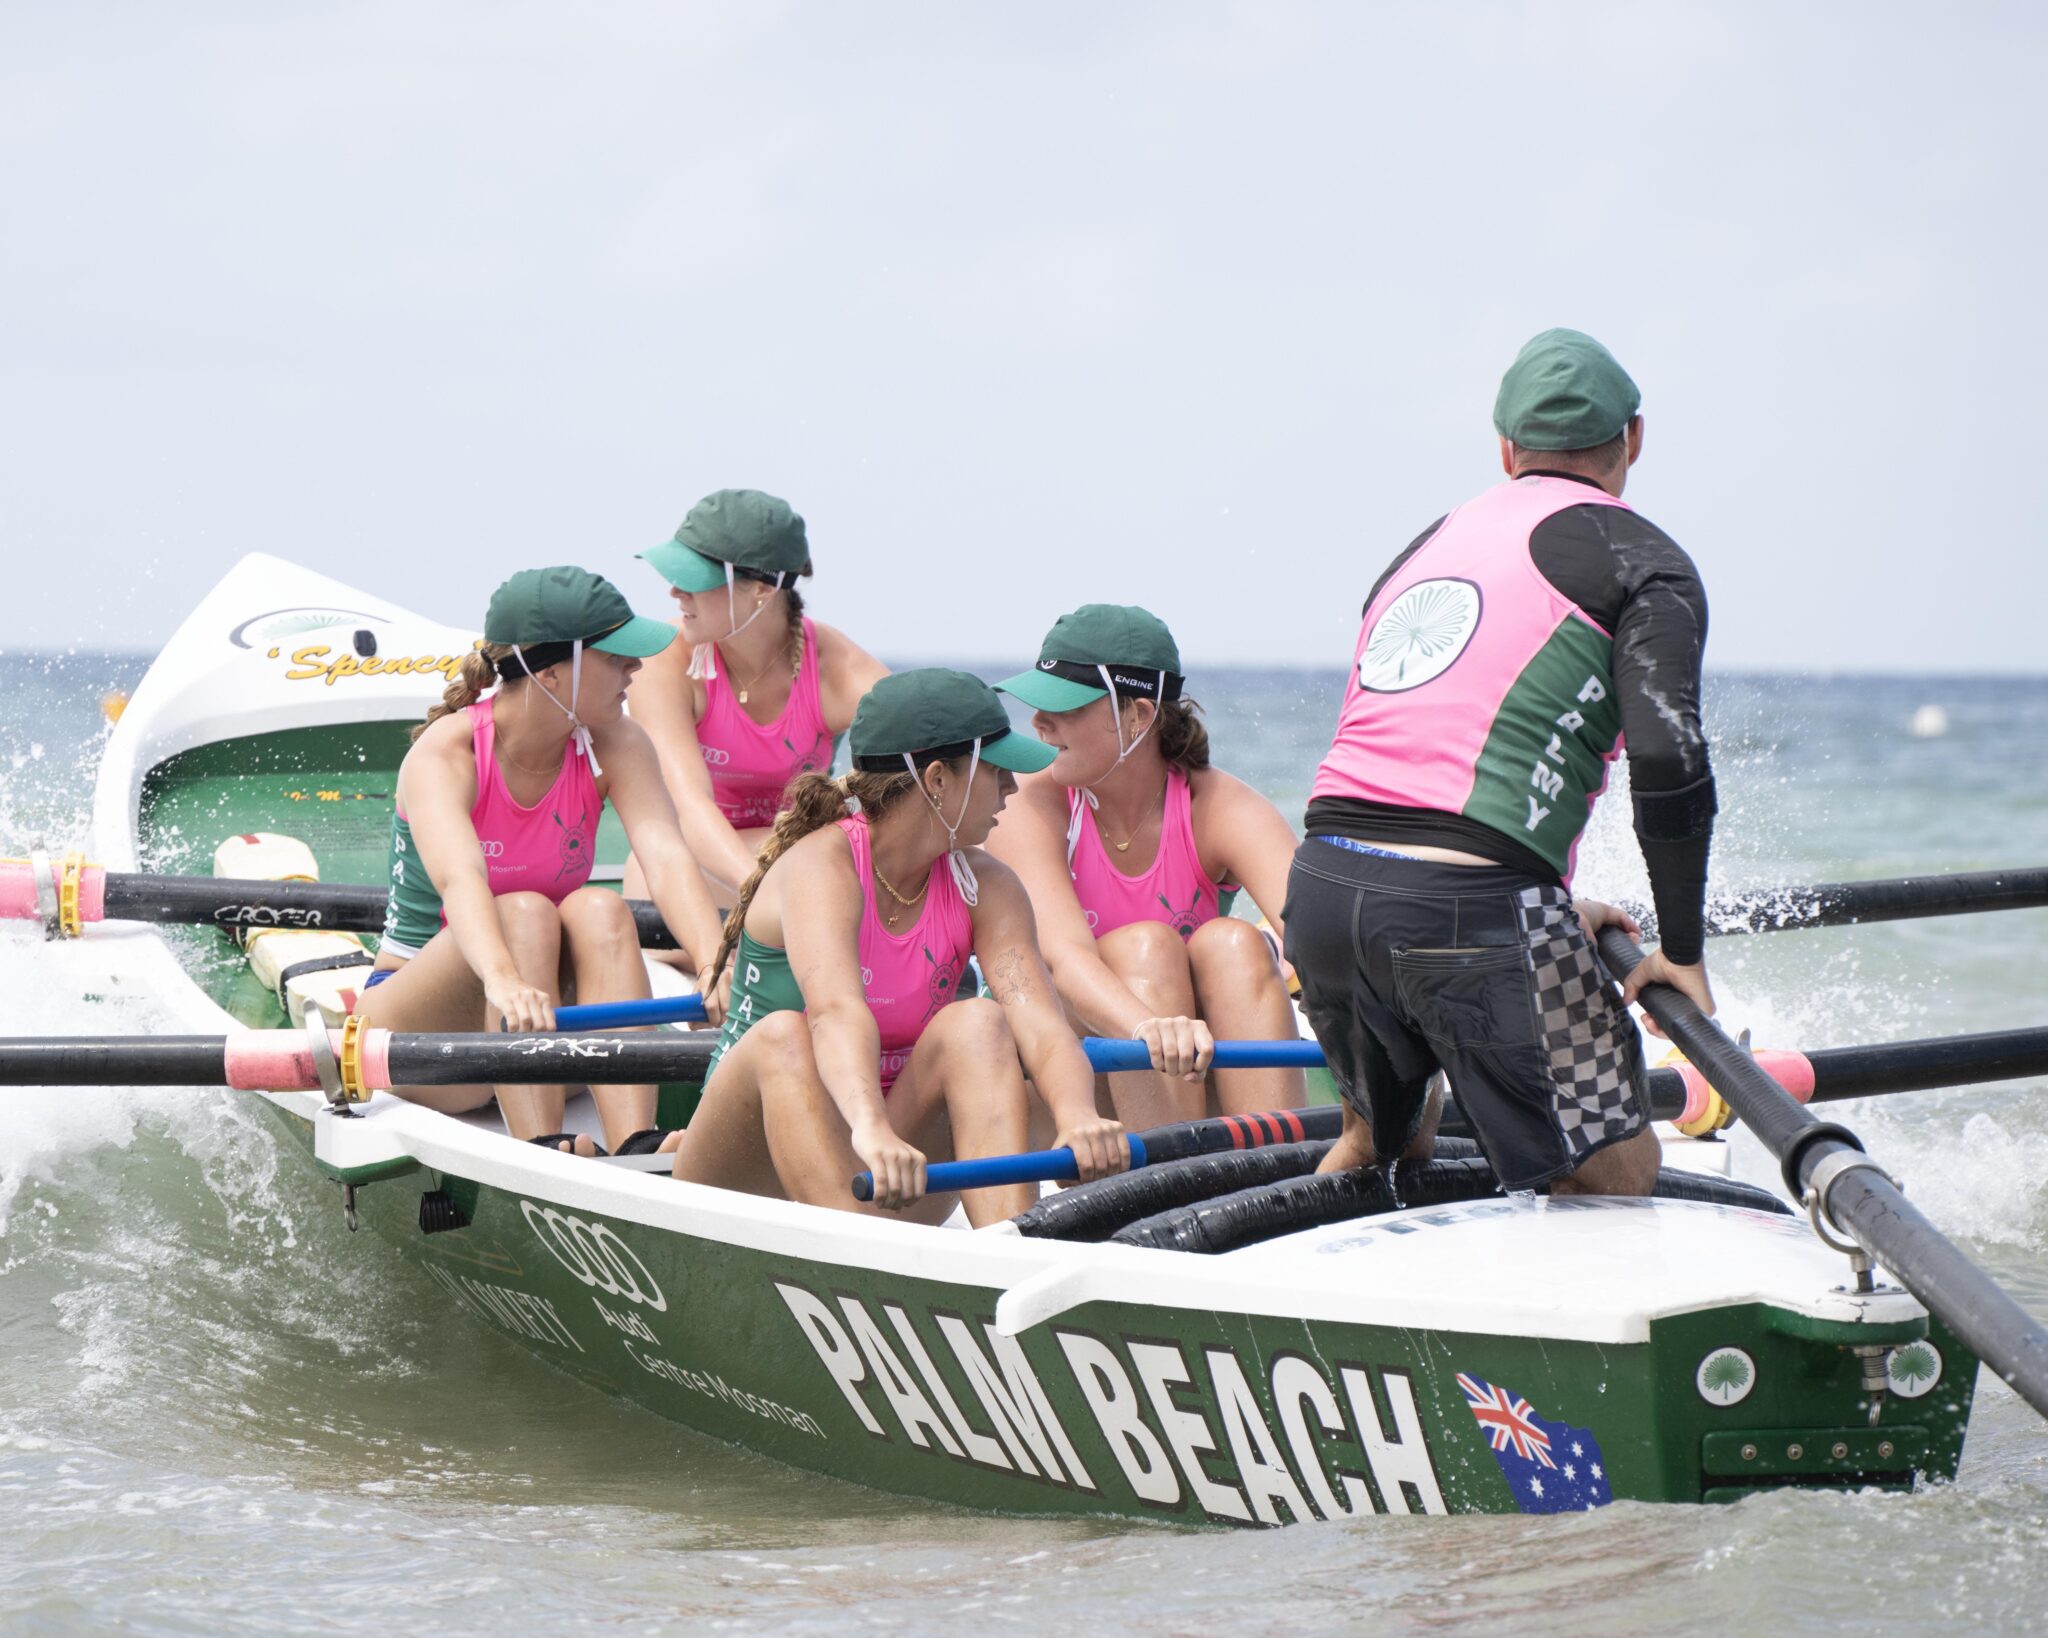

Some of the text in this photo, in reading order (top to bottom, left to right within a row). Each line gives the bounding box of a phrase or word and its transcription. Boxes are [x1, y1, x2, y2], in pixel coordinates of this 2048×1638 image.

[1114, 674, 1154, 691] ENGINE
[489, 863, 528, 875] Mosman
[459, 1276, 587, 1353] SOCIETY
[591, 1296, 661, 1346] Audi
[622, 1339, 829, 1439] Centre Mosman
[772, 1281, 1451, 1527] PALM BEACH
